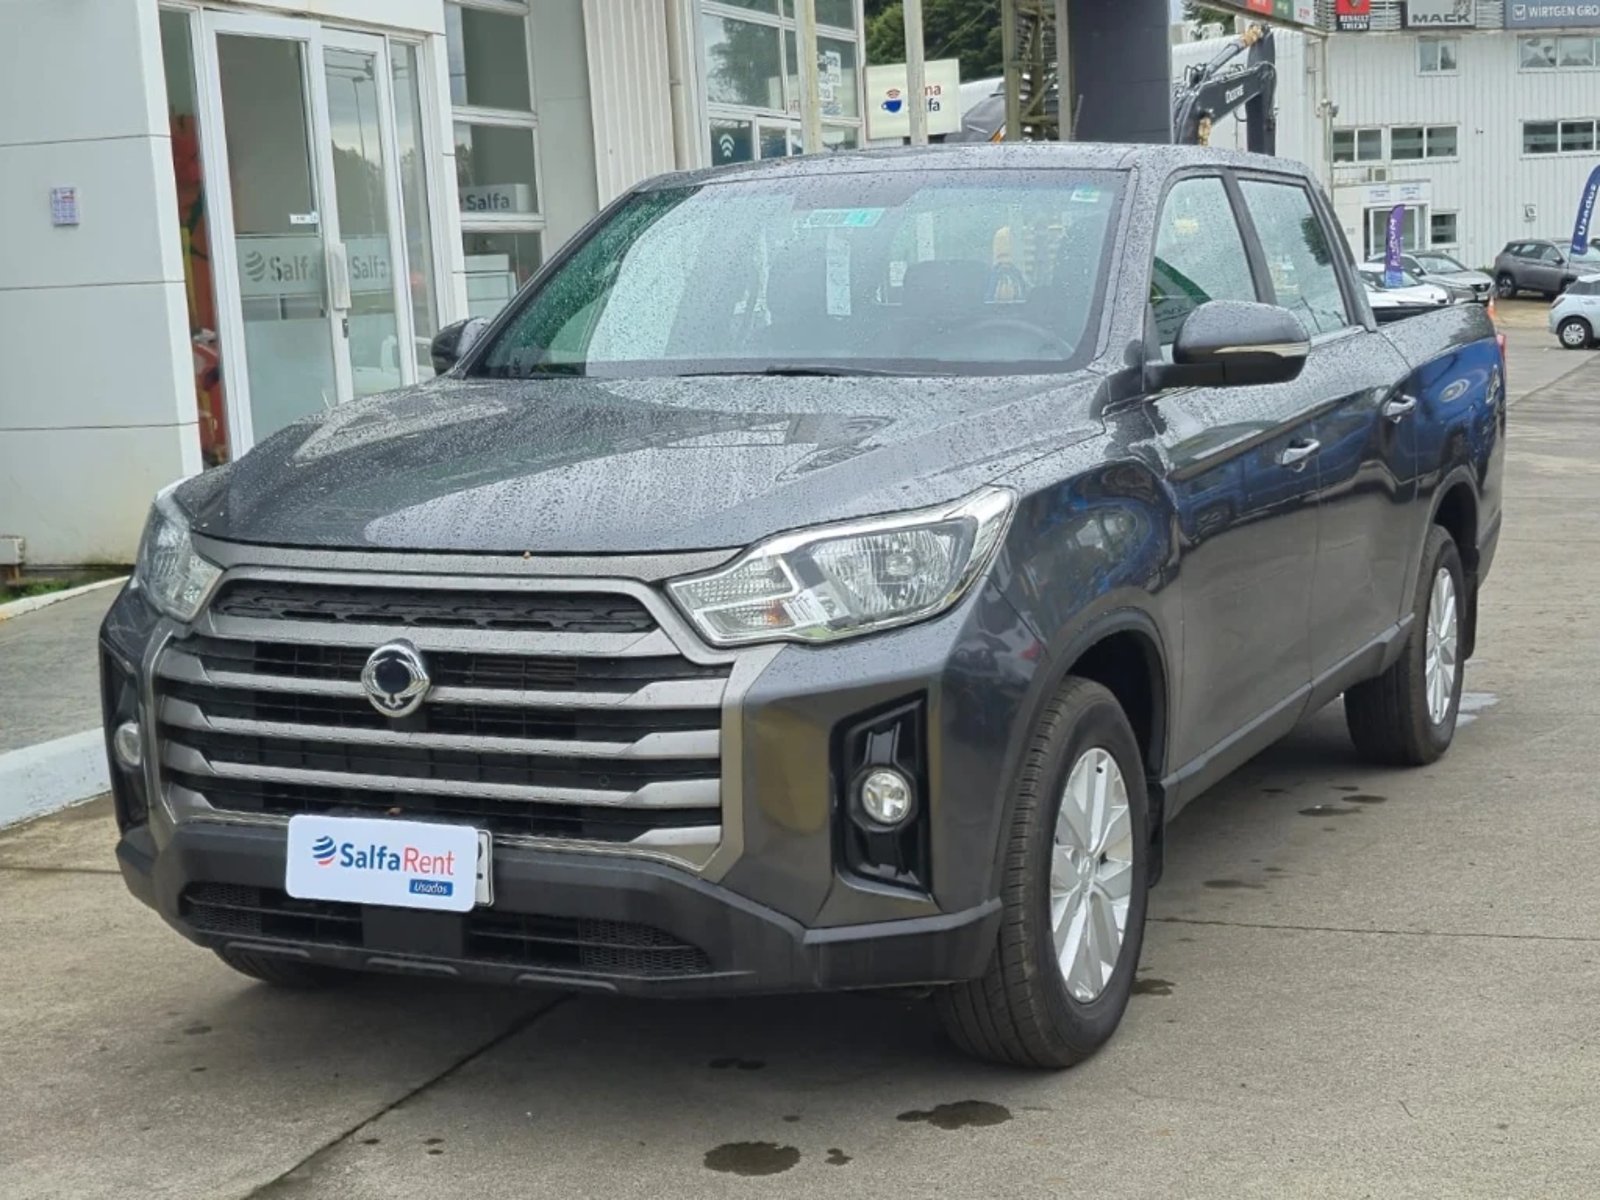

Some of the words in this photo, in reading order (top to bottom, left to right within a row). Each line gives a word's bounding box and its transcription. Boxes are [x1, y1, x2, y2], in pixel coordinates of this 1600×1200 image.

[1528, 6, 1575, 17] WIRTGEN
[1412, 14, 1470, 23] MACK
[924, 85, 941, 96] na
[466, 192, 510, 211] Salfa
[414, 882, 448, 895] Usados
